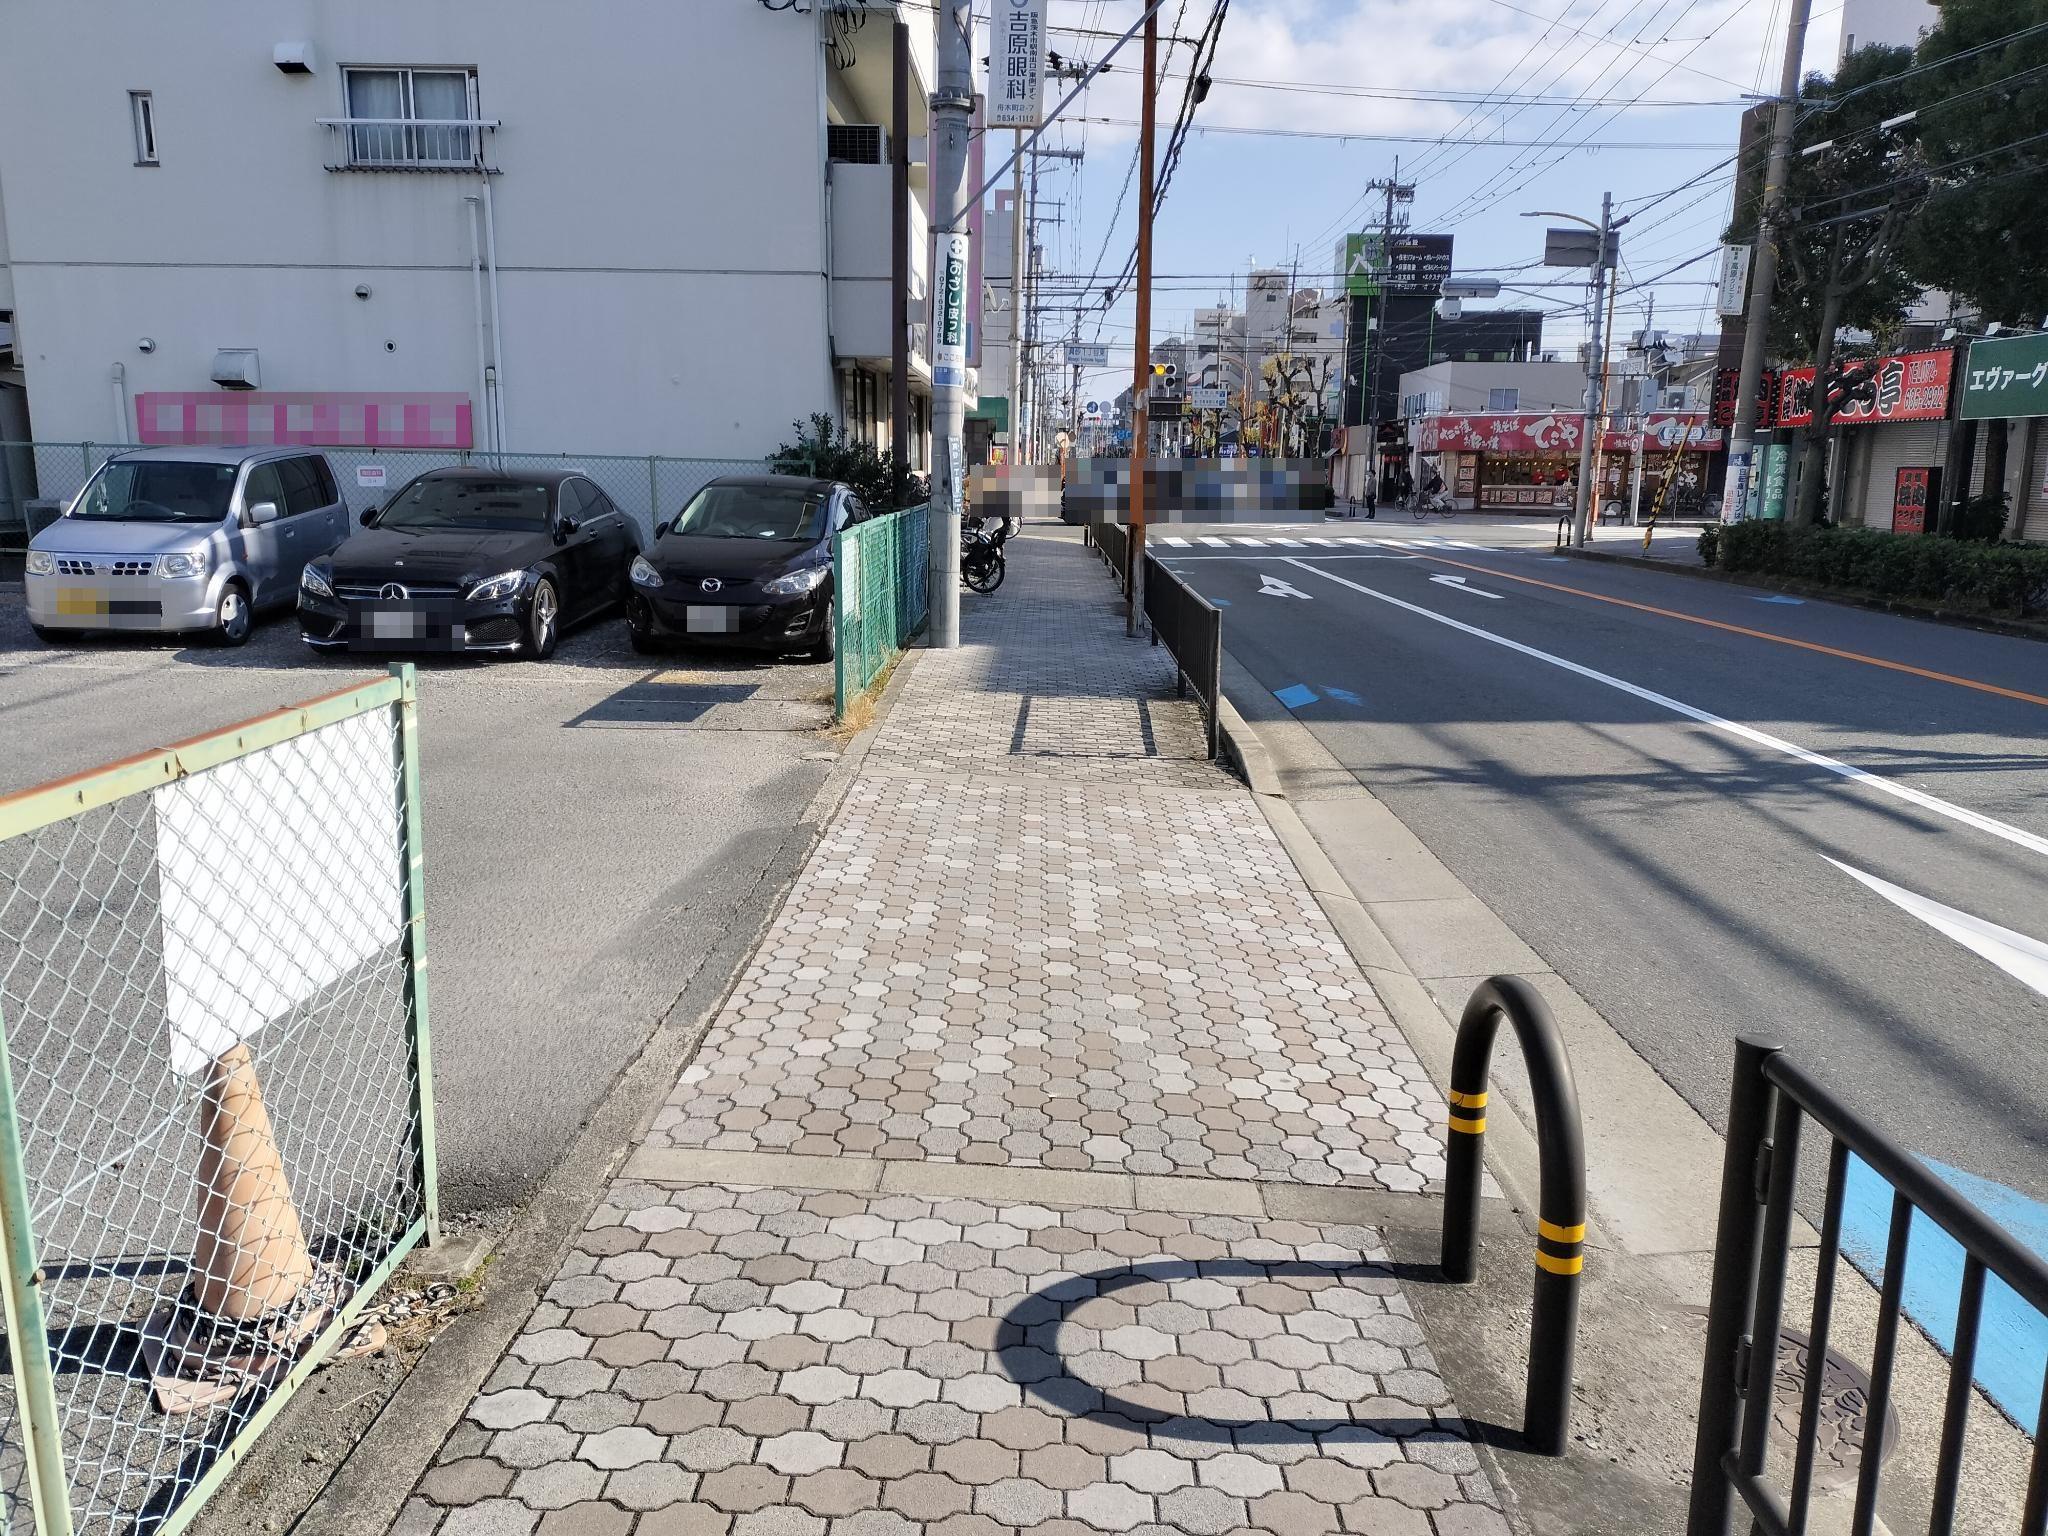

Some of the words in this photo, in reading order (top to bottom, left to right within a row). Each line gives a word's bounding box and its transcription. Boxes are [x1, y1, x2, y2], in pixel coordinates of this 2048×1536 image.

[1006, 10, 1029, 100] 吉原眼科
[1970, 361, 2048, 392] エヴァーグ
[1440, 418, 1472, 441] たこ焼
[1492, 416, 1520, 434] 焼そば
[1523, 415, 1579, 450] てこや
[1775, 450, 1789, 500] 冷凍食品
